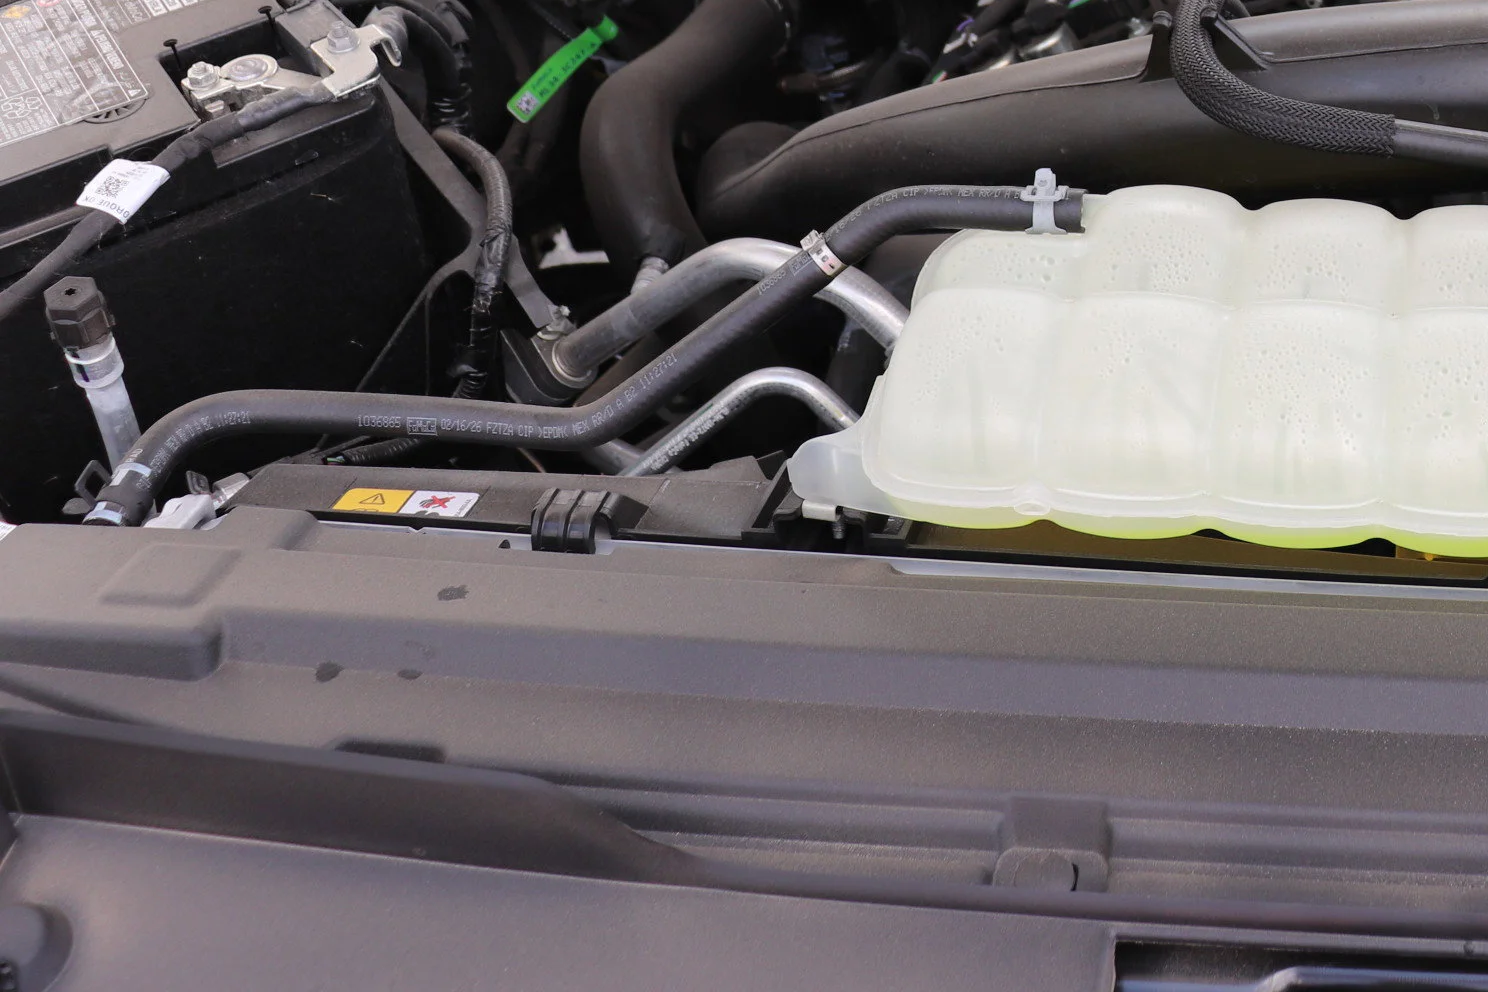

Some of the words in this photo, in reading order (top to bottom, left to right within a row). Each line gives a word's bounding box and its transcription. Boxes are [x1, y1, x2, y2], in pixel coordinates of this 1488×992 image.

[357, 415, 401, 428] 1036865
[440, 418, 482, 433] 02/16/26
[517, 425, 534, 438] CIP
[572, 419, 591, 436] MEX
[615, 399, 624, 410] A
[624, 386, 638, 402] B2
[639, 352, 678, 389] 11:27:21
